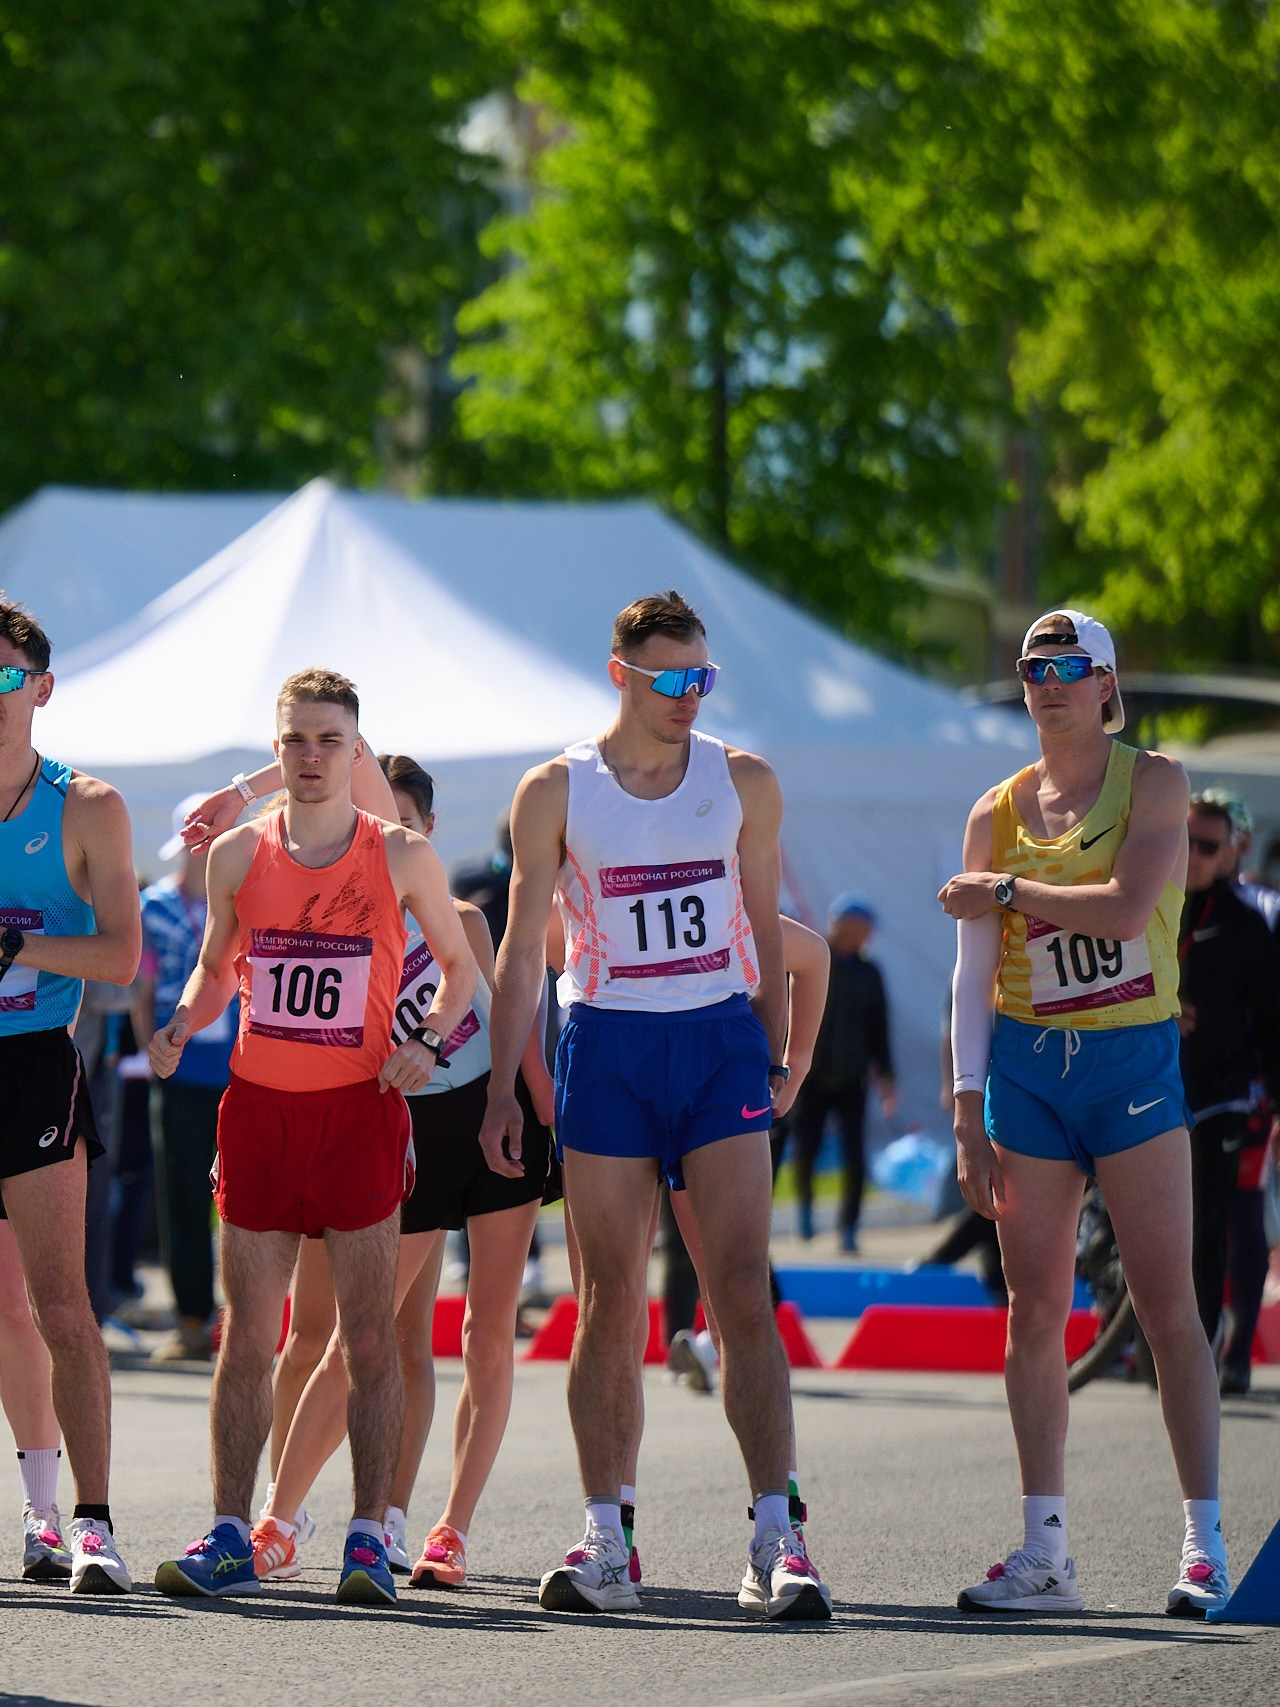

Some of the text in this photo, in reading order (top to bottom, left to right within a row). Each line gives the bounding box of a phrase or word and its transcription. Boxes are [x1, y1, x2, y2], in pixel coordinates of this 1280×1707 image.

[604, 867, 713, 884] ЧЕМПИОНАТ РОССИИ
[613, 881, 642, 889] ходьбе
[629, 895, 707, 952] 113
[254, 936, 360, 952] ЧЕМПИОНАТ РОССИИ
[401, 949, 431, 977] ОССИИ
[1046, 932, 1123, 988] 109
[268, 963, 342, 1021] 106
